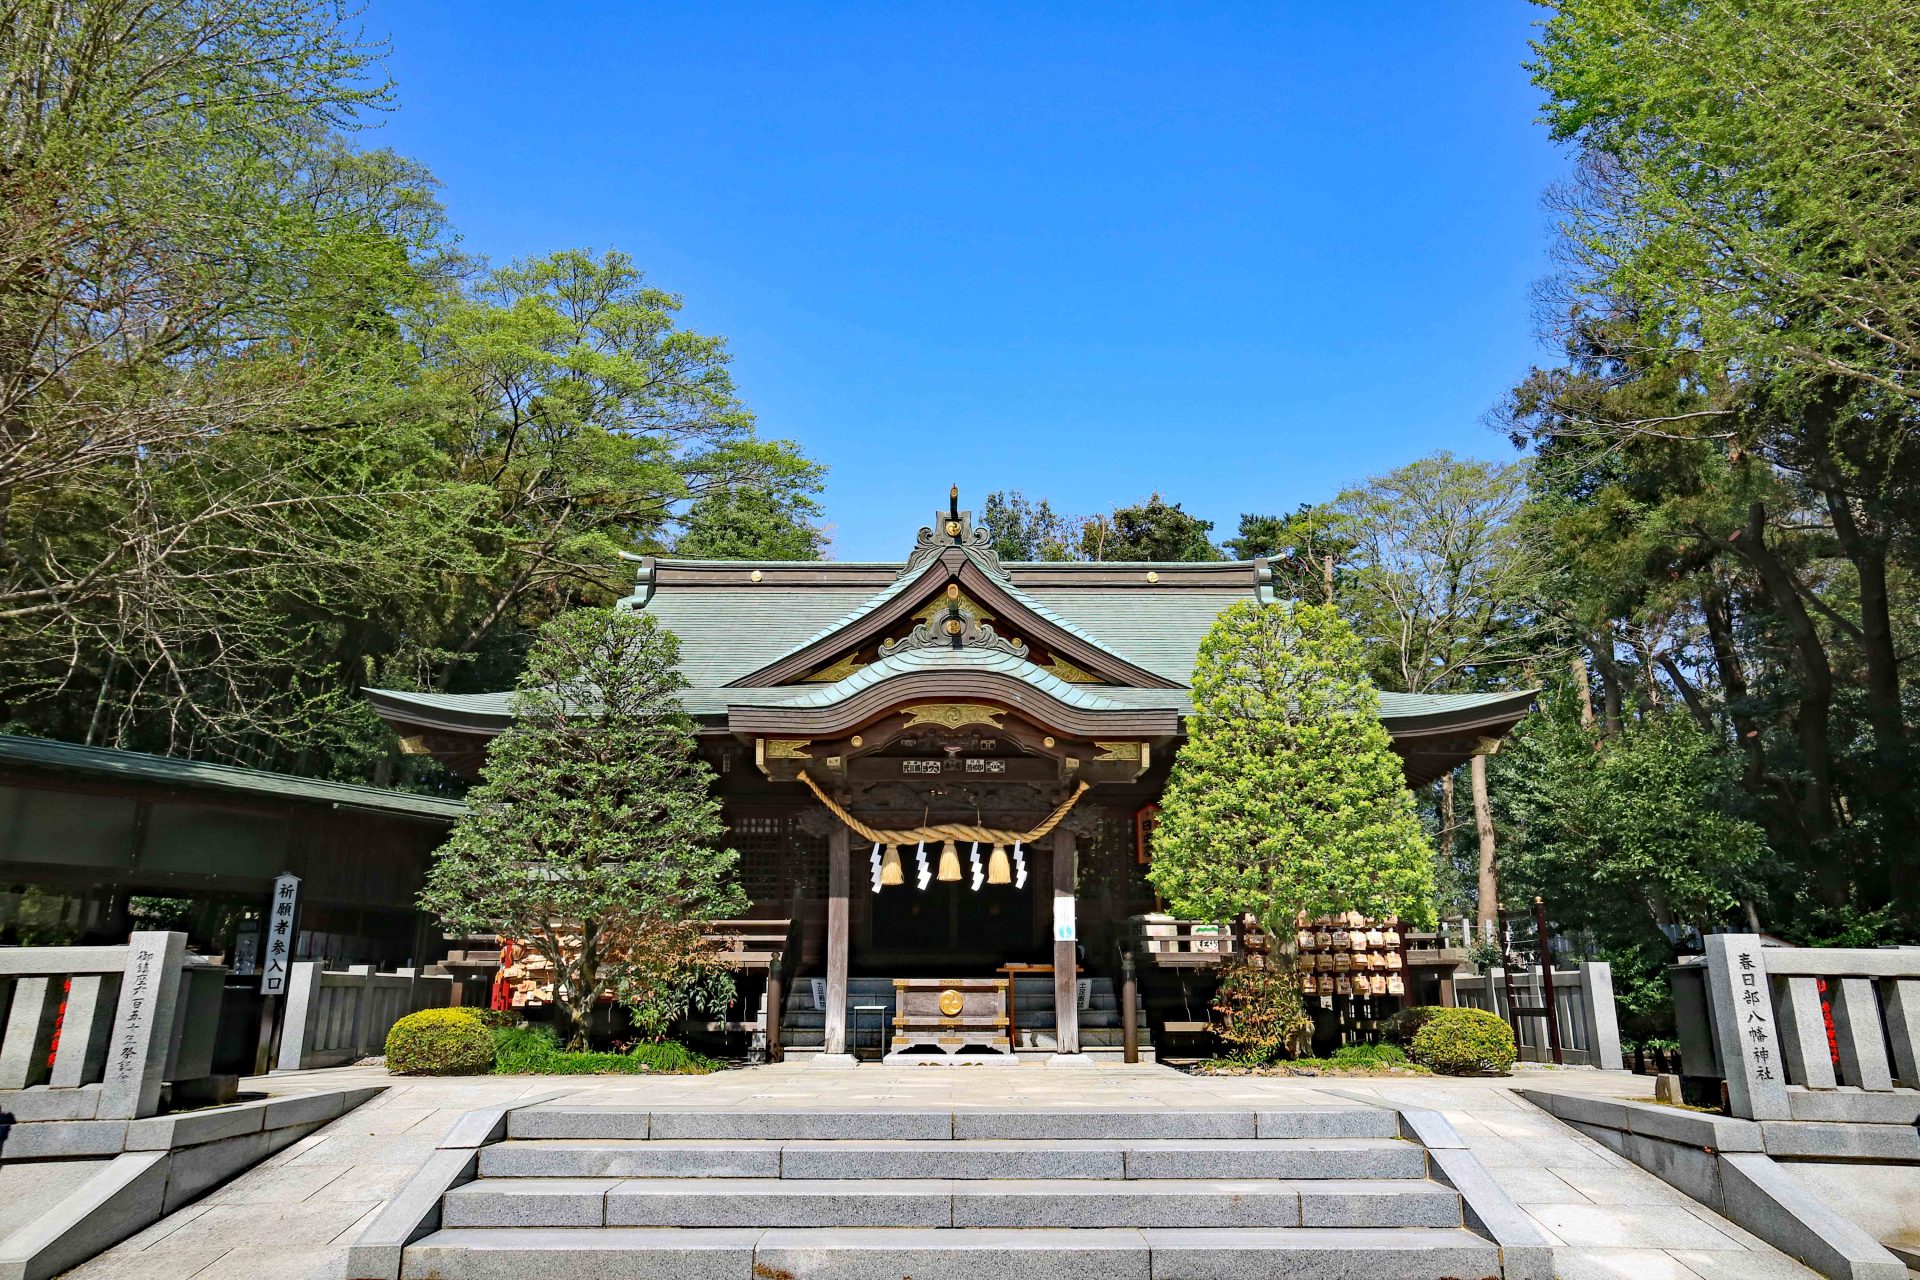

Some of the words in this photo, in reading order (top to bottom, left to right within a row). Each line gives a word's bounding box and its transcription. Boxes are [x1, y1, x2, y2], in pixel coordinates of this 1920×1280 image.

[268, 884, 294, 989] 祈願者参入口
[116, 950, 154, 1083] 御鎮座六百五十年祭記念
[1739, 952, 1774, 1080] 春日部八幡神社
